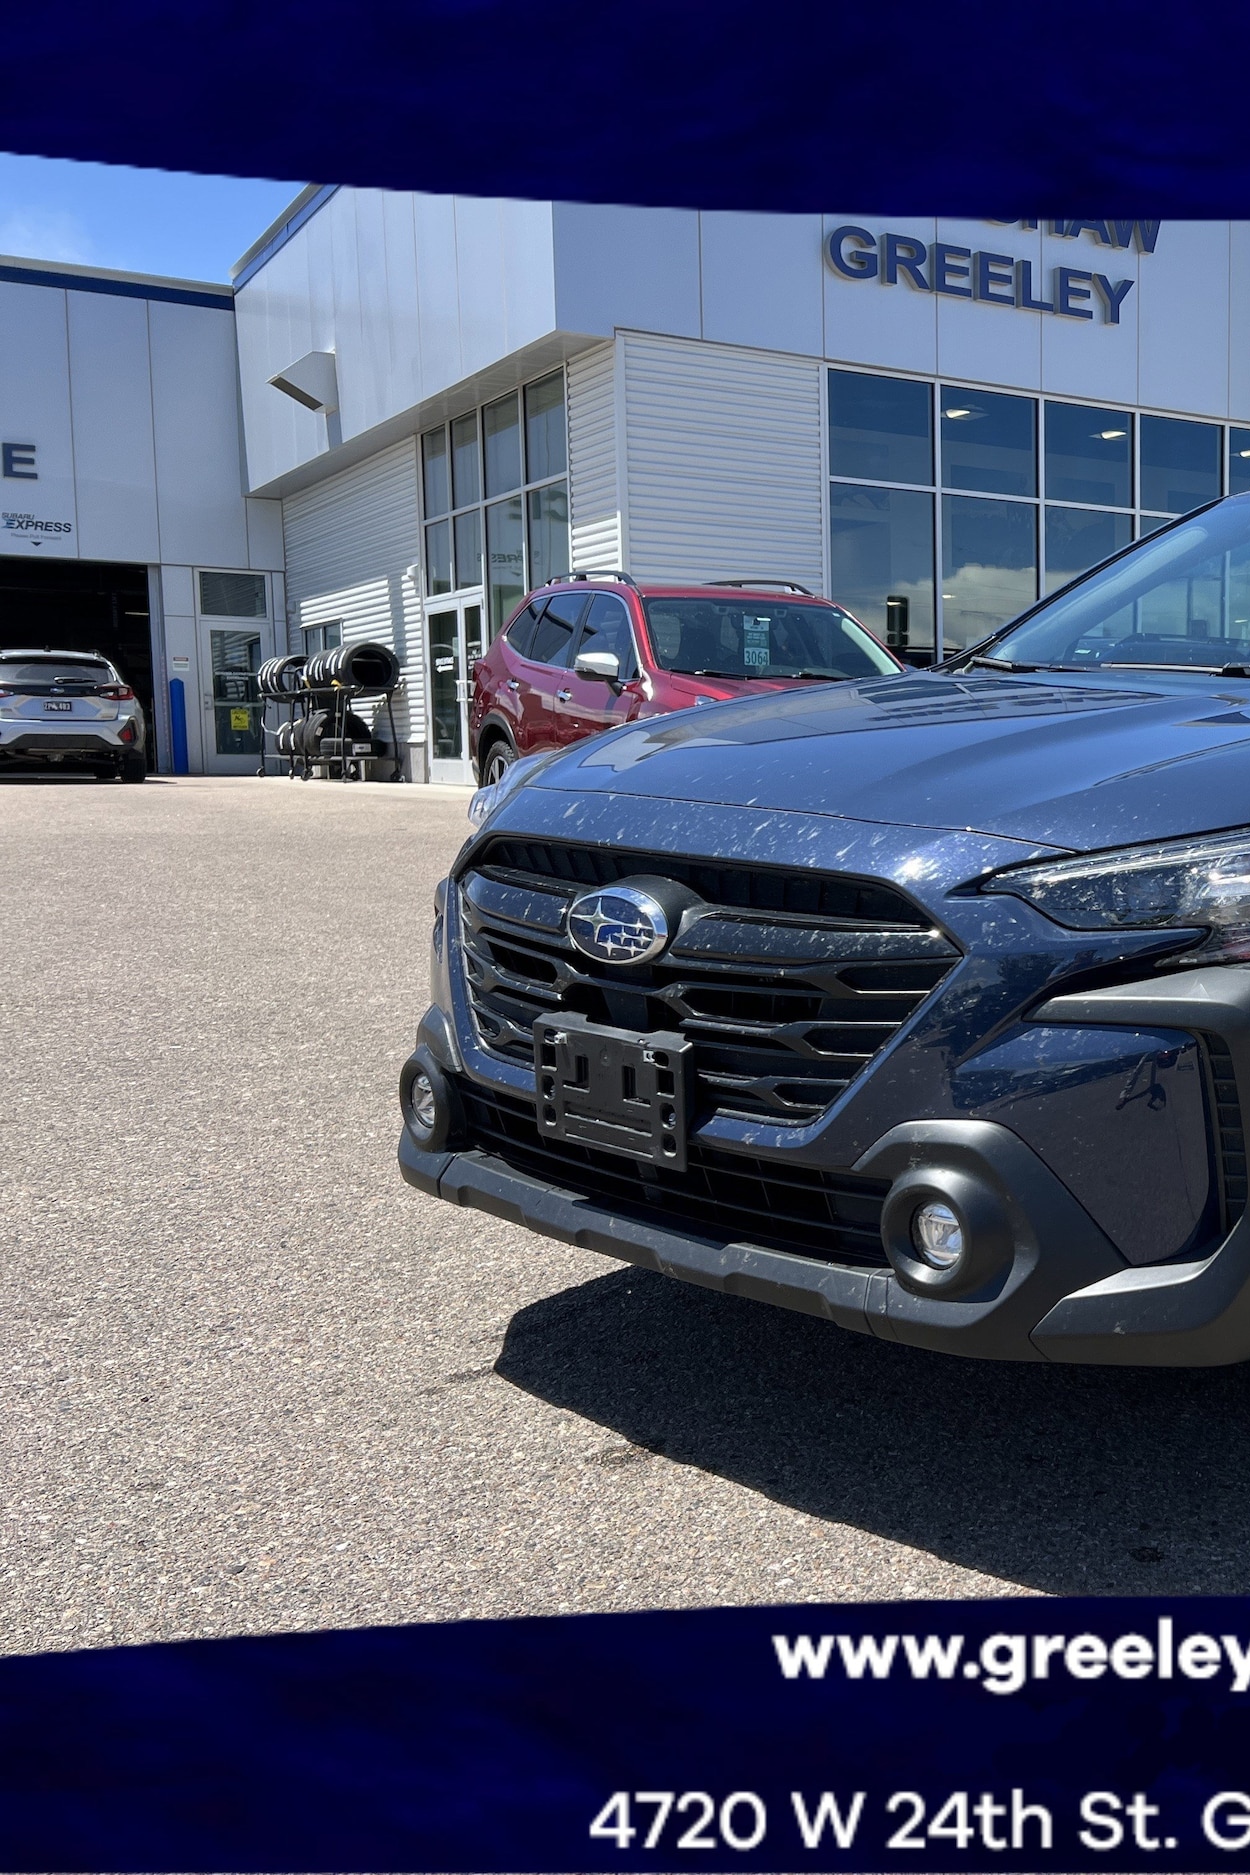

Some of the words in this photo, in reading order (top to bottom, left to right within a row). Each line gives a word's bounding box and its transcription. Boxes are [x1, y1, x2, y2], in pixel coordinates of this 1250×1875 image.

[984, 216, 1161, 254] AW
[824, 225, 1135, 326] GREELEY
[1, 519, 72, 533] EXPRESS
[2, 512, 35, 520] SUBARU
